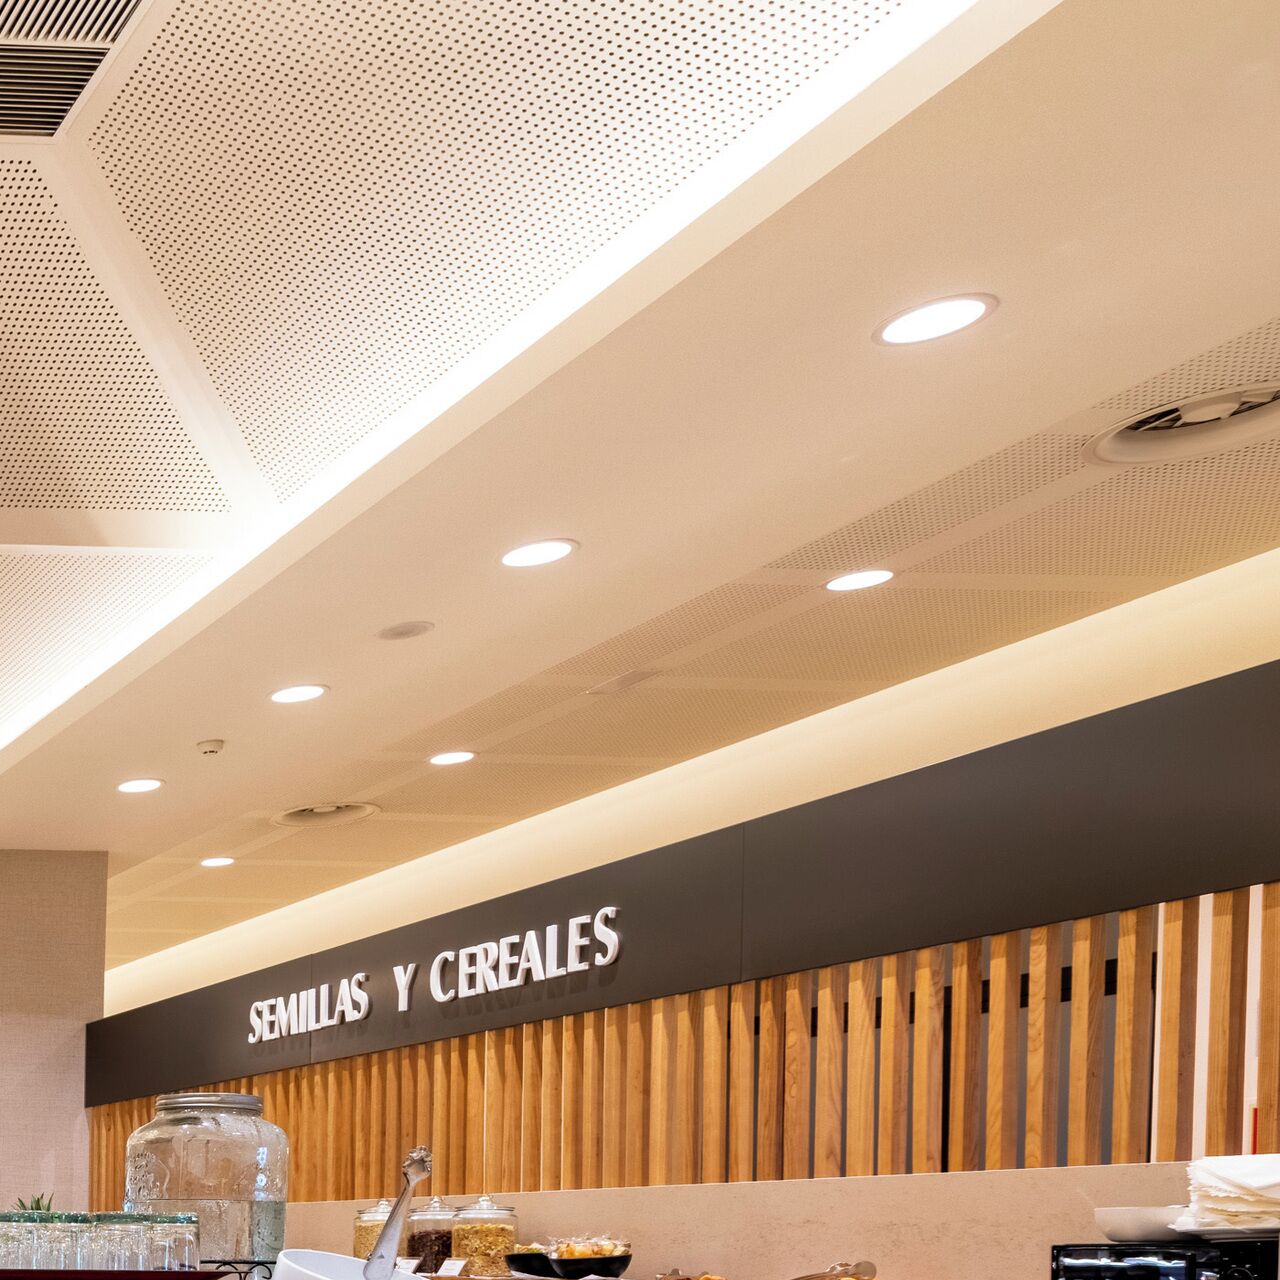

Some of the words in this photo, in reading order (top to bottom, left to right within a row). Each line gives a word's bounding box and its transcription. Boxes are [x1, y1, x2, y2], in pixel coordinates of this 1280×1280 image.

[247, 972, 370, 1044] SEMILLAS
[391, 962, 419, 1012] Y
[429, 906, 620, 1004] CEREALES
